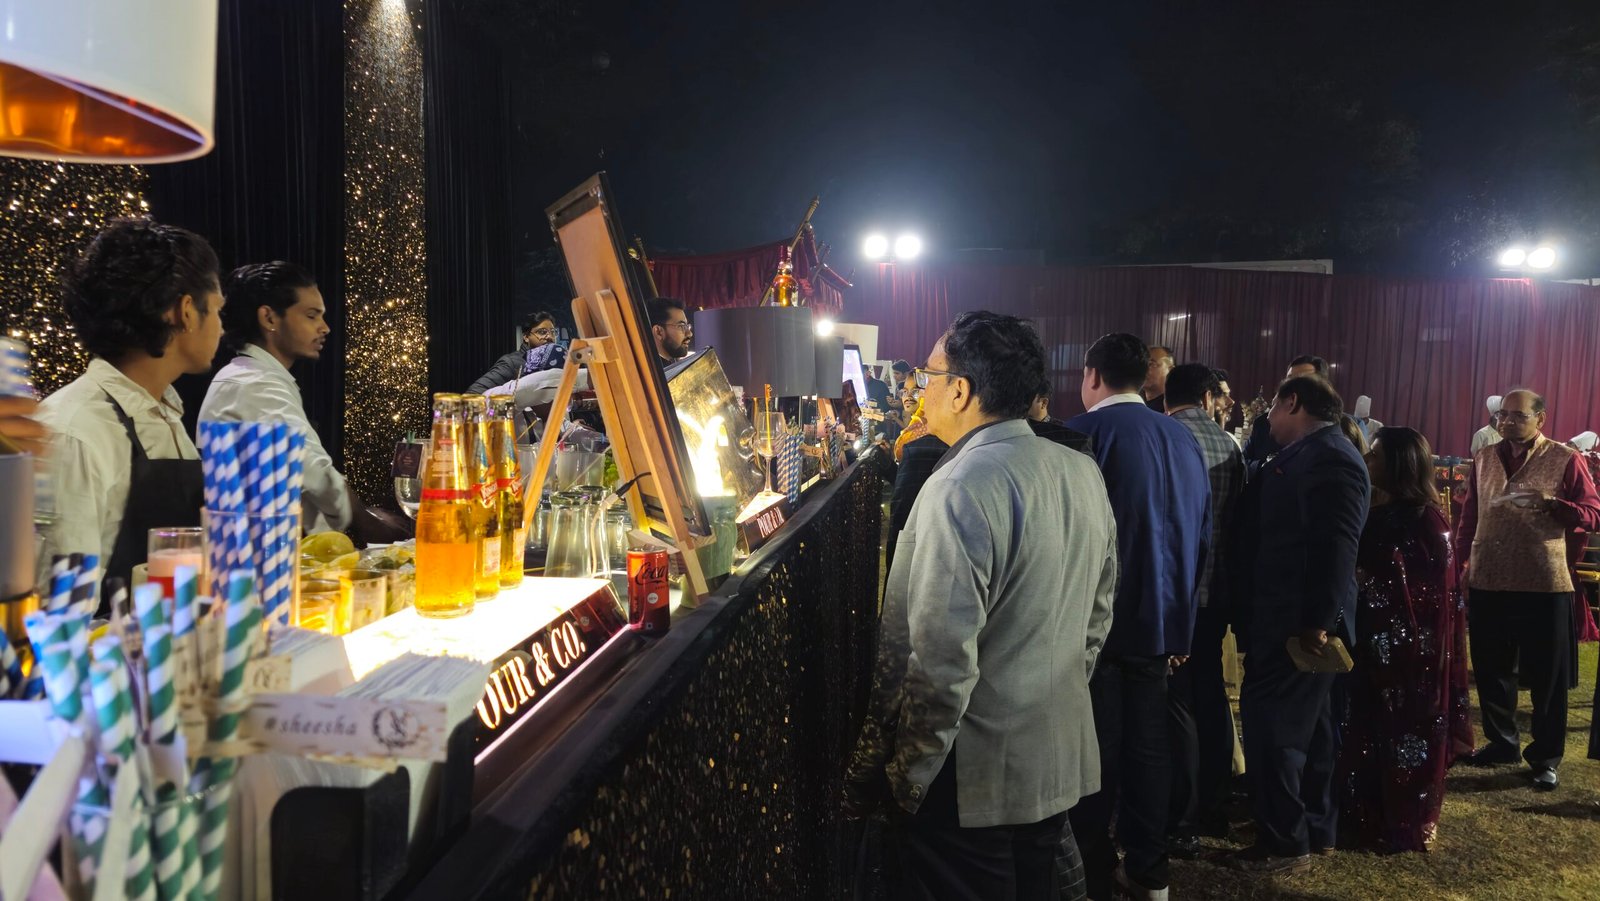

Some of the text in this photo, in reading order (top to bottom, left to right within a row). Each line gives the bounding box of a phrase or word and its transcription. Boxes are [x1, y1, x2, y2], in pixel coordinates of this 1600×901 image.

[474, 656, 536, 729] OUR
[532, 641, 556, 687] &
[551, 620, 586, 668] CO.
[264, 713, 358, 736] #sheesha
